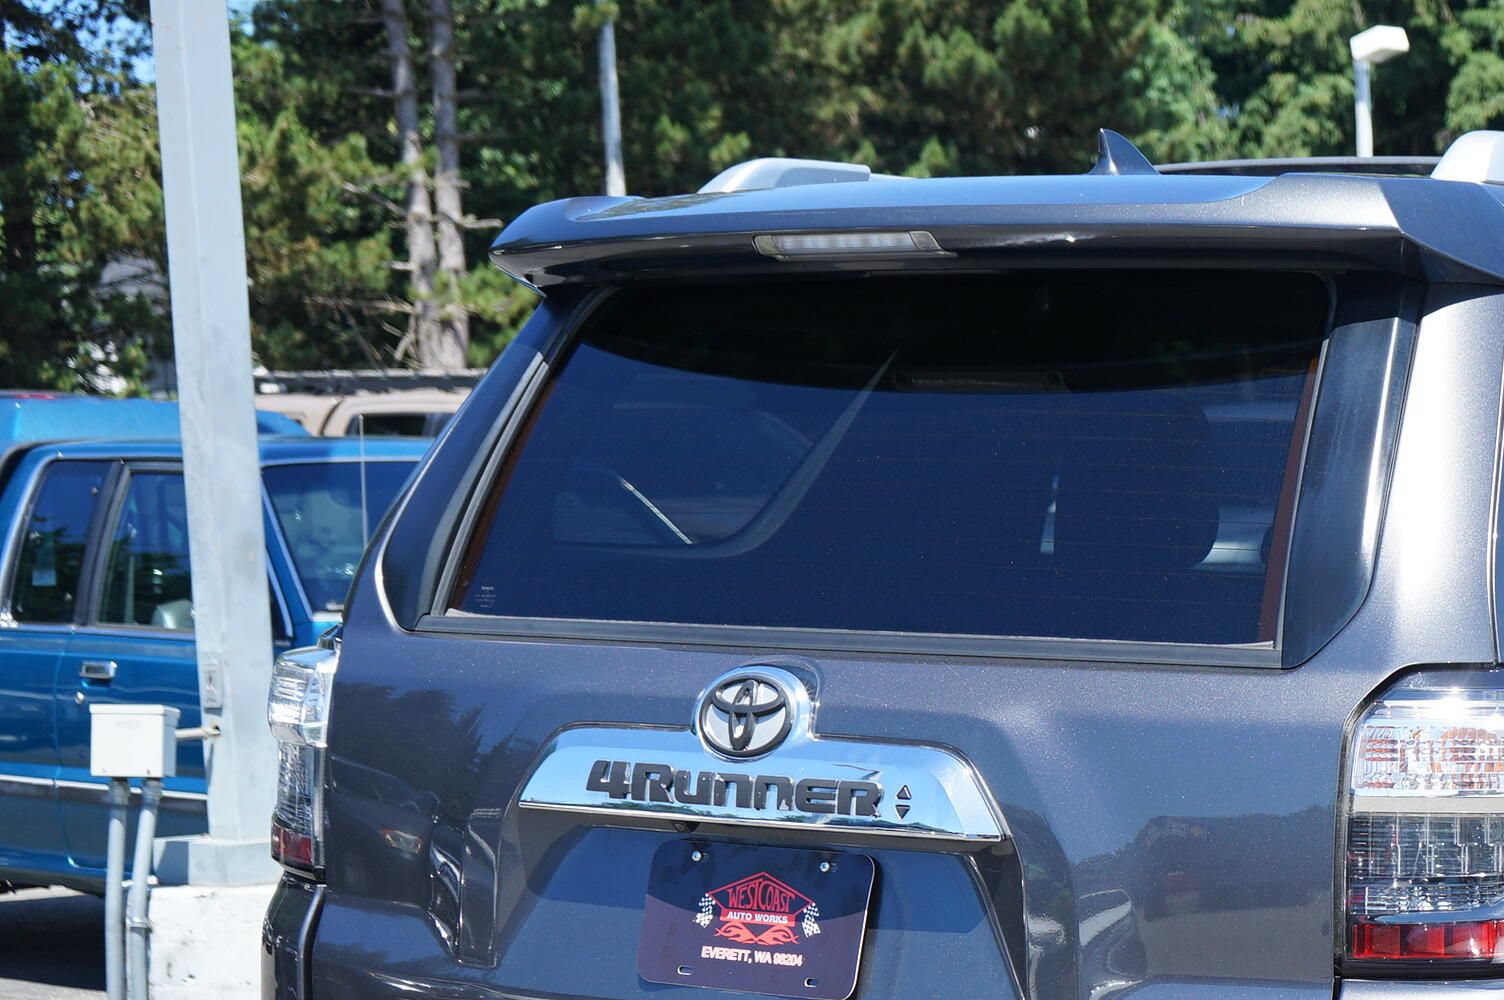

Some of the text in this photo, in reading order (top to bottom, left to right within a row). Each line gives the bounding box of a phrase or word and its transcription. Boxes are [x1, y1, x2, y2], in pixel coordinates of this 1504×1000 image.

[727, 911, 788, 924] AUTO WORKS
[754, 950, 772, 964] WA
[773, 953, 803, 967] 98204
